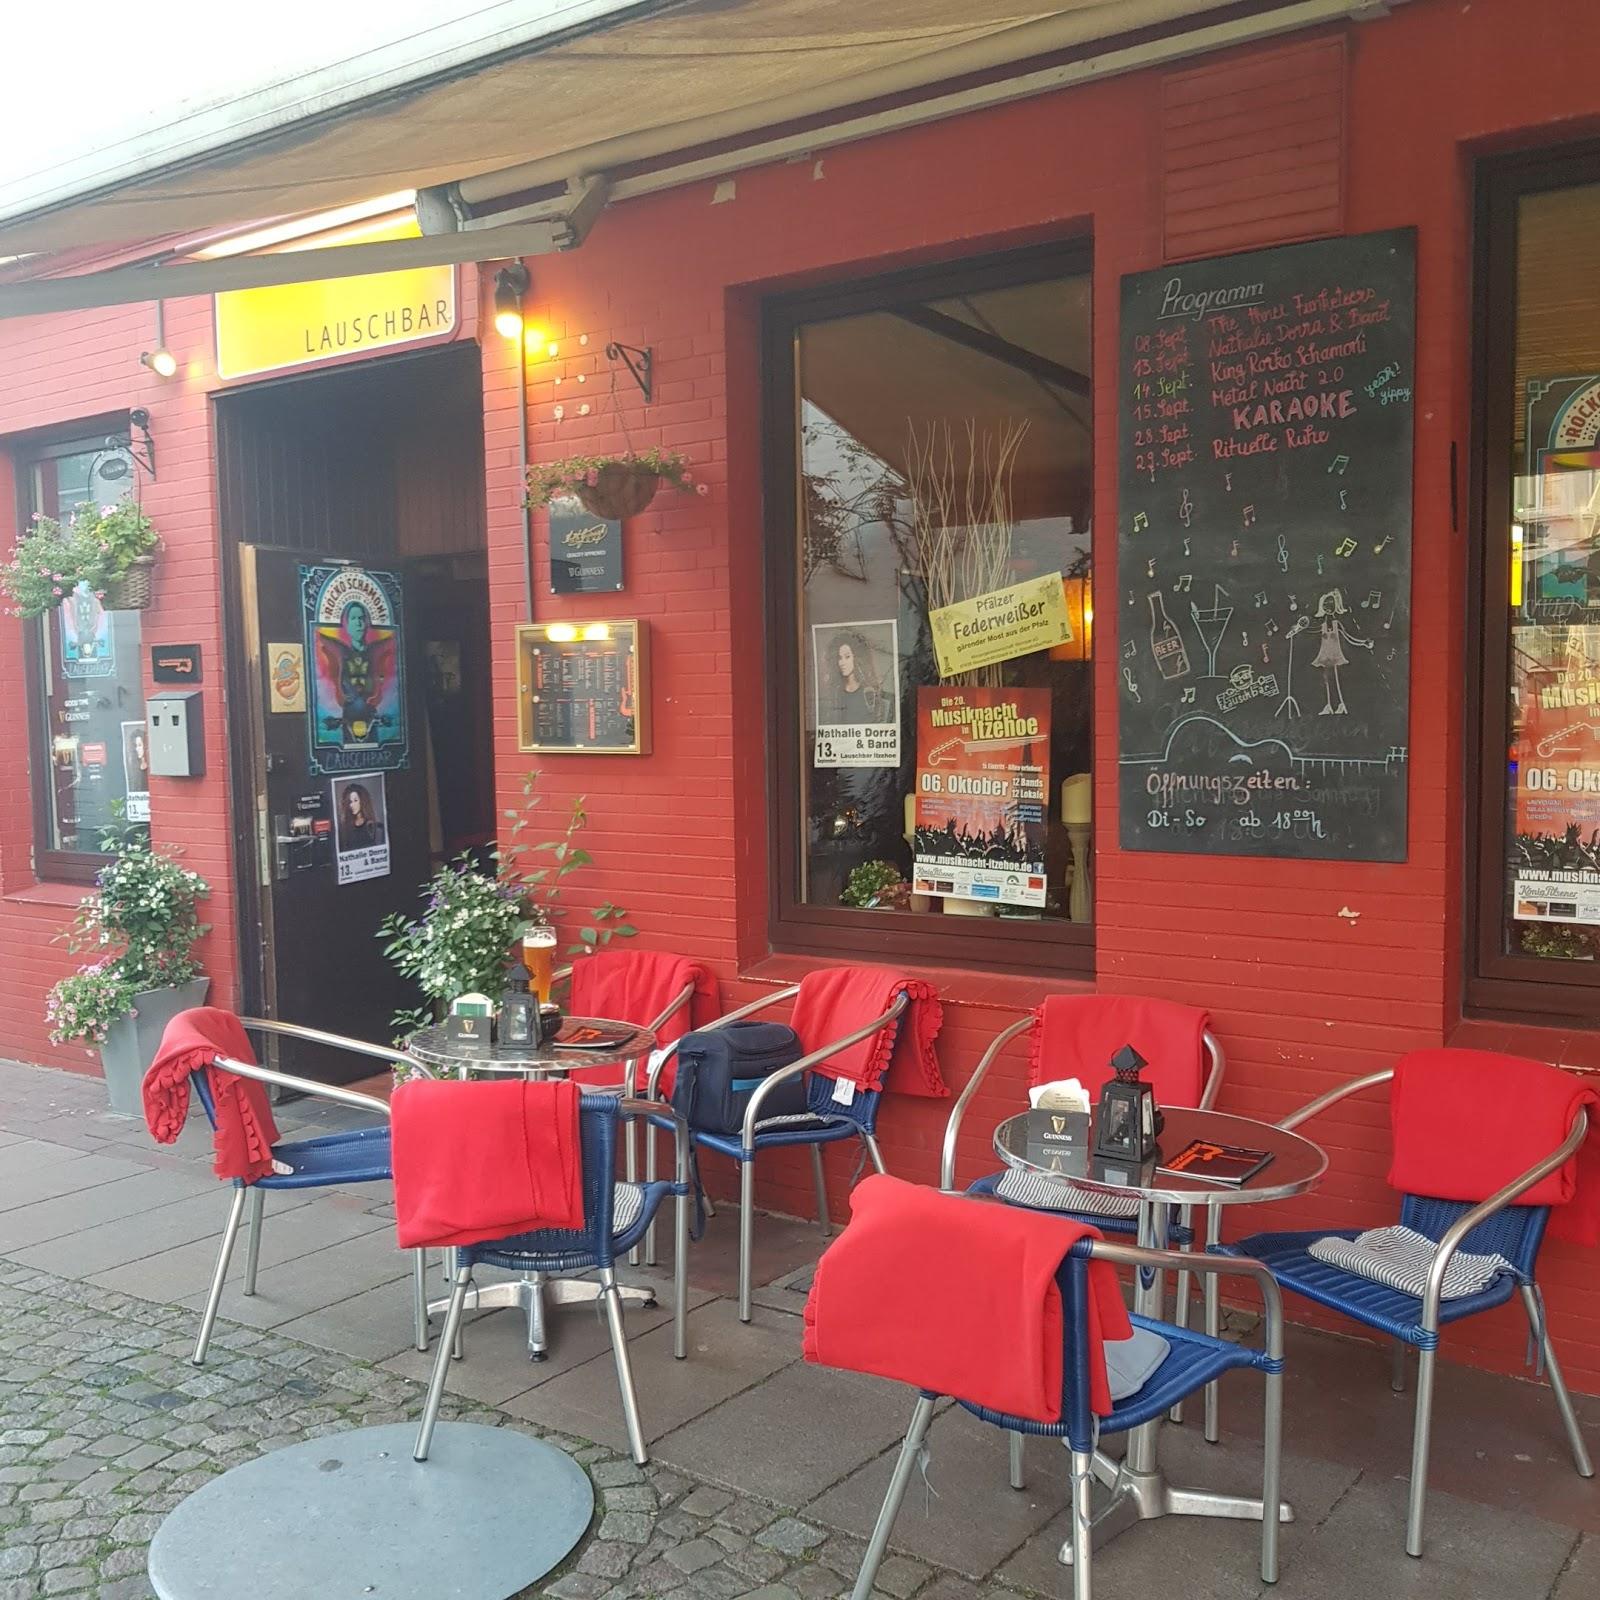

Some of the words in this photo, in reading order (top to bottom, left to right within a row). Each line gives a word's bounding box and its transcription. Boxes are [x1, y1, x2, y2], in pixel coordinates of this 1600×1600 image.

[1160, 278, 1264, 321] Programm
[305, 299, 449, 353] LAUSCHBAR
[1330, 314, 1344, 332] &
[1348, 300, 1392, 328] Band
[1212, 361, 1247, 386] King
[1212, 385, 1258, 408] Metal
[1263, 371, 1309, 397] Nacht
[1318, 366, 1345, 386] 2.0
[1232, 390, 1358, 431] KARAOKE
[1212, 432, 1278, 460] Rituelle
[1285, 423, 1330, 449] Ruhe
[324, 579, 347, 616] ROCKO
[975, 593, 1015, 613] Pfälzer
[953, 601, 1046, 640] Federweißer
[987, 633, 1004, 642] Most
[1005, 629, 1018, 637] aus
[1020, 625, 1031, 634] der
[1032, 620, 1049, 630] Pfalz
[1154, 639, 1180, 655] BEER
[1558, 671, 1575, 683] Die
[1578, 669, 1595, 682] 20.
[931, 703, 1018, 727] Musiknacht
[817, 728, 861, 739] Nathalie
[864, 728, 896, 738] Dorra
[971, 717, 1039, 741] Itzehoe
[817, 742, 837, 758] 13.
[856, 739, 864, 749] &
[867, 739, 897, 749] Band
[921, 774, 945, 792] 06.
[947, 775, 1009, 796] Oktober
[1012, 778, 1020, 787] 12
[1021, 778, 1043, 788] Bands
[1527, 768, 1563, 792] 06.
[1012, 789, 1019, 798] 12
[1020, 789, 1044, 799] Lokale
[1239, 810, 1260, 827] ab
[340, 864, 353, 877] 13.
[915, 854, 1033, 873] www.musiknacht-itzehoe.de
[1519, 869, 1600, 884] www.musikn
